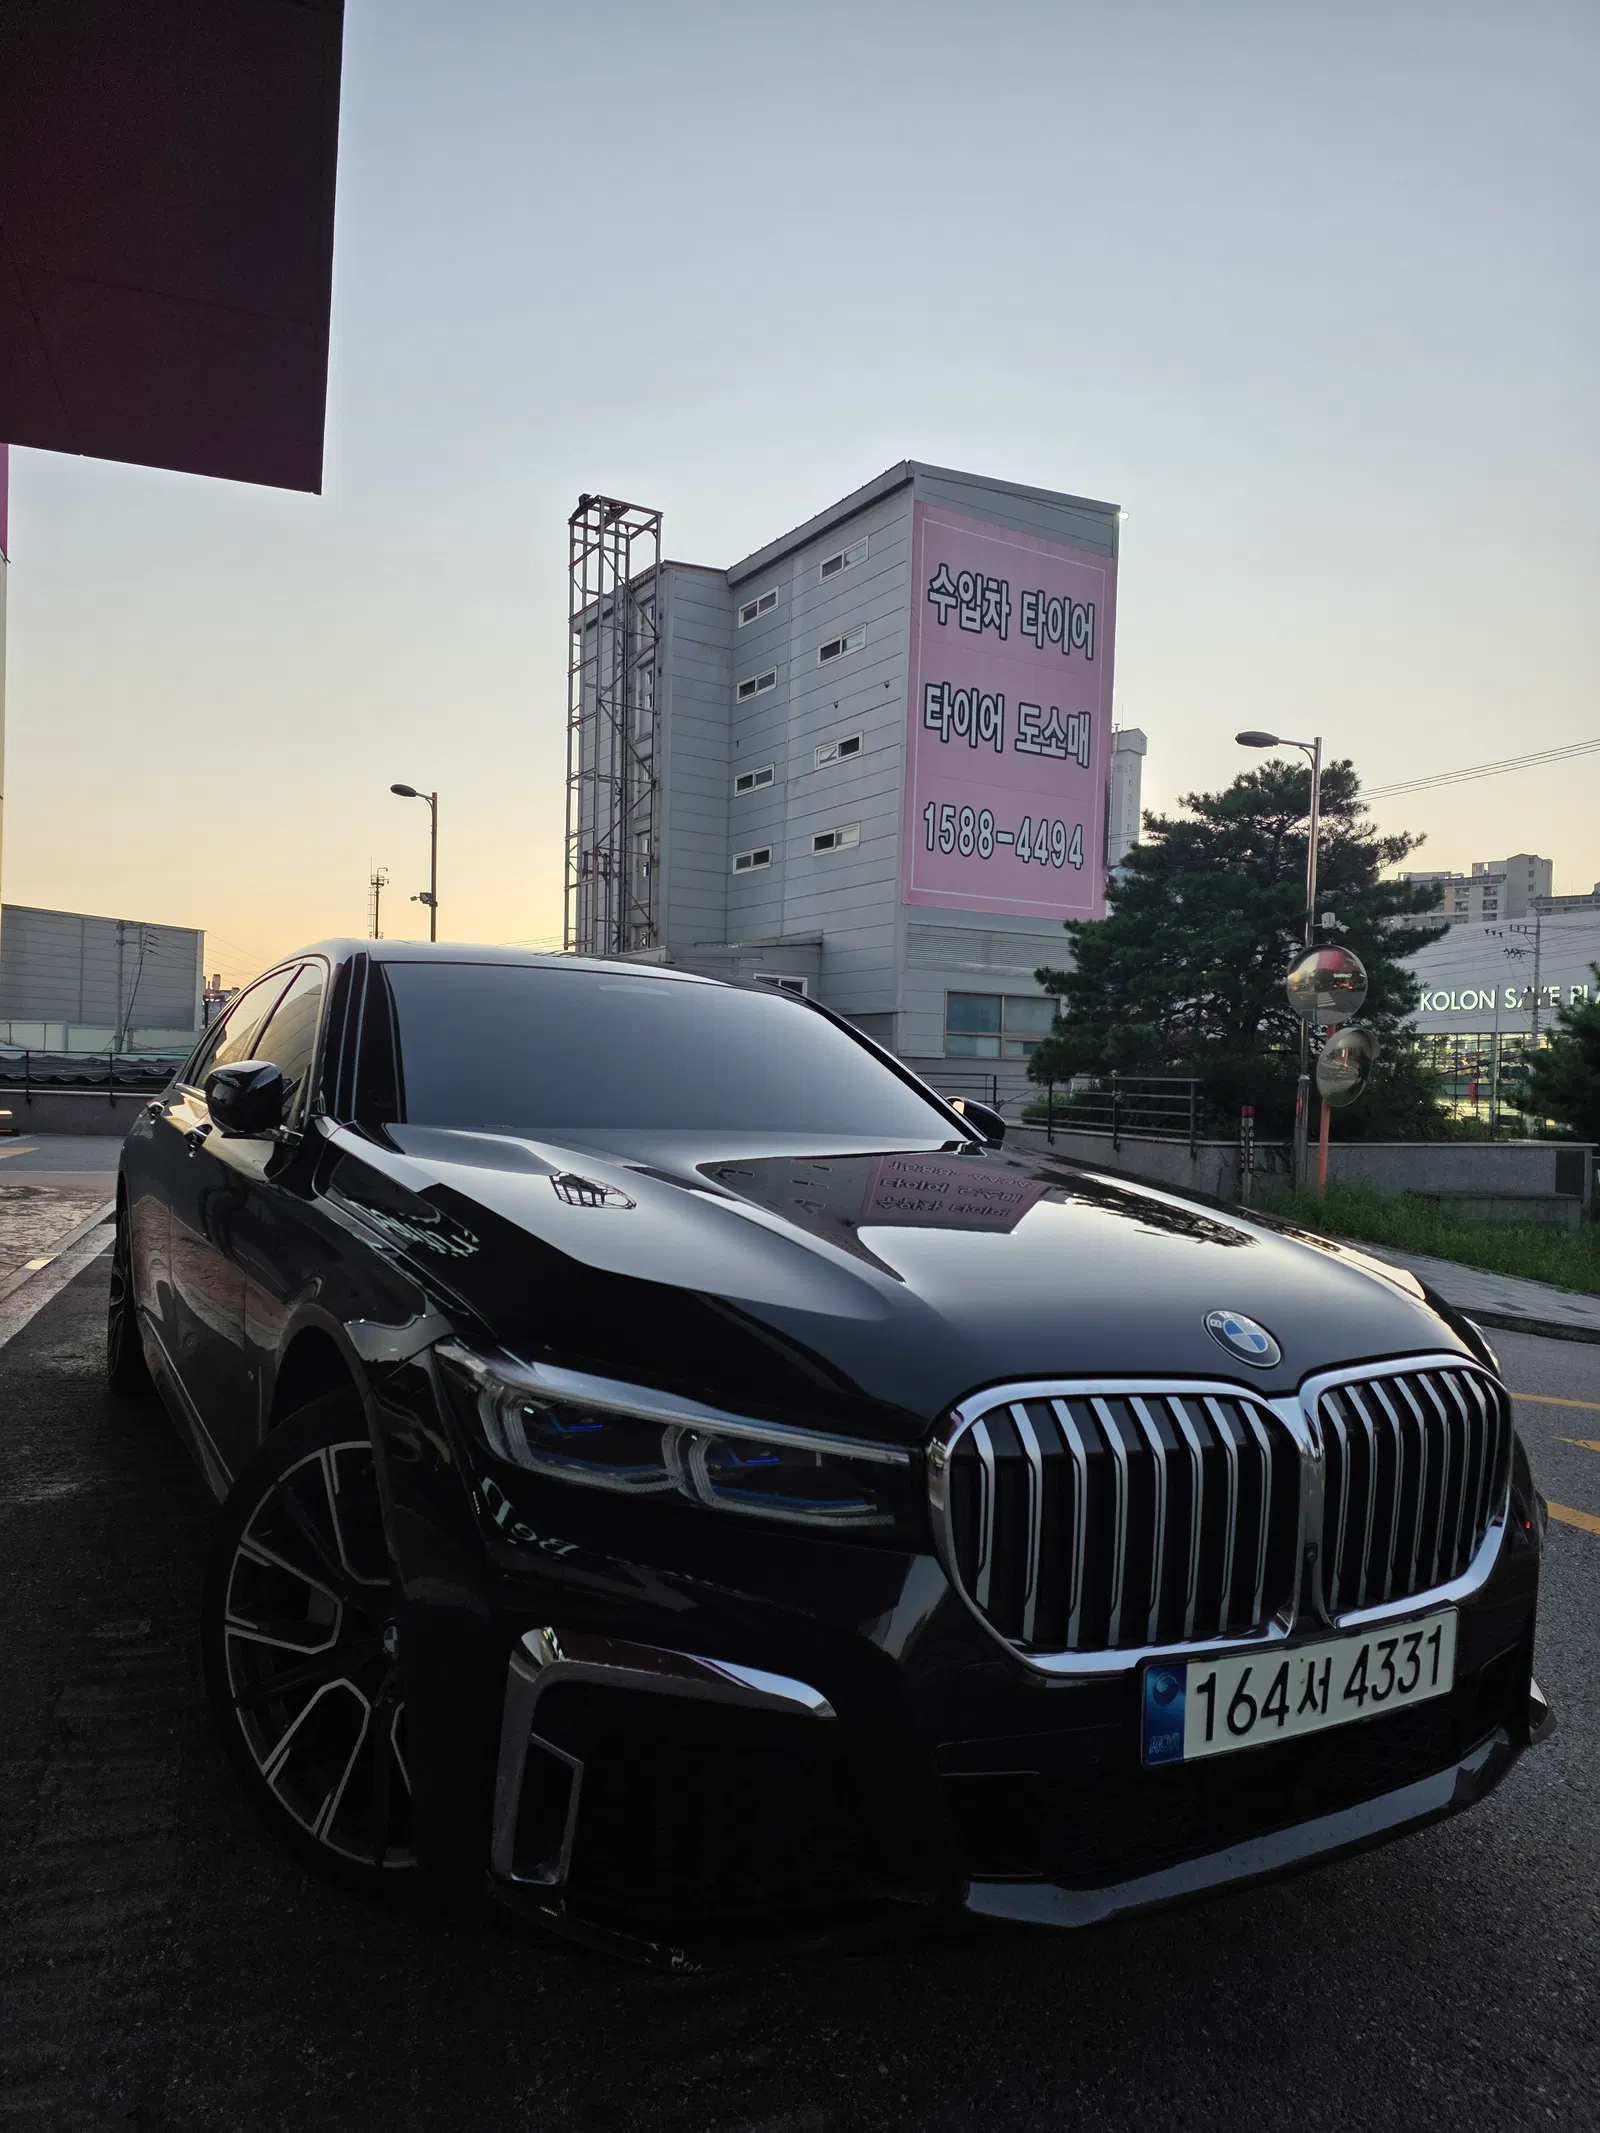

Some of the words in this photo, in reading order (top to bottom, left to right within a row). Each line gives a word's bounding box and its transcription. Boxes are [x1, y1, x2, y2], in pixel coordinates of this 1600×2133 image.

[928, 563, 1011, 640] 수입차
[1021, 589, 1096, 660] 타이어
[924, 681, 1005, 753] 타이어
[1014, 702, 1091, 768] 도소매
[923, 801, 1084, 869] 1588-4494
[1420, 989, 1496, 1012] KOLON
[1196, 1657, 1332, 1742] 164서
[1343, 1624, 1442, 1707] 4331
